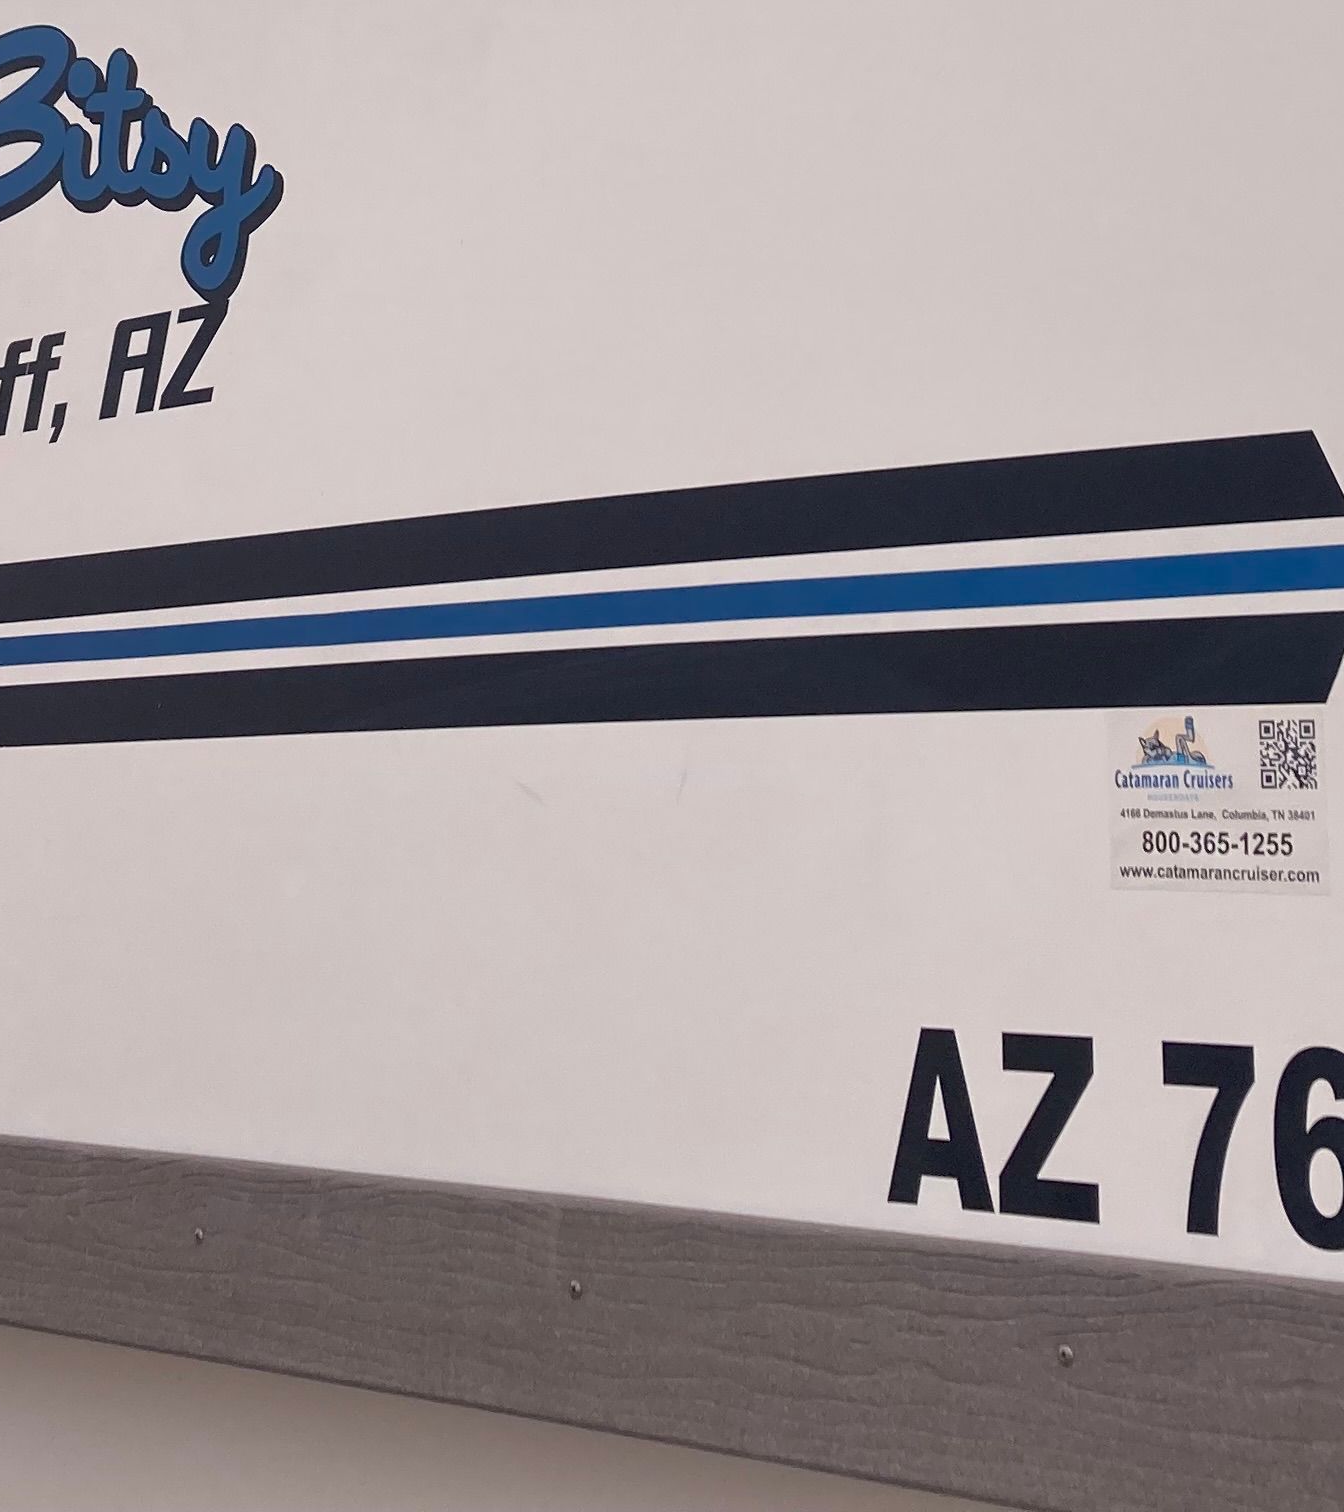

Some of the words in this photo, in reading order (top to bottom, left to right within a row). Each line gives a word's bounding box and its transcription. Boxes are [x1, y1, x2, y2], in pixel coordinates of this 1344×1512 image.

[98, 298, 230, 420] AZ
[1114, 769, 1179, 789] Catamaran
[1183, 770, 1234, 790] Cruisers
[1190, 808, 1217, 820] Lane,
[1222, 809, 1269, 822] Columbia,
[1271, 809, 1285, 820] TN
[1288, 809, 1316, 821] 38401
[1141, 830, 1294, 857] 800-365-1255
[1119, 864, 1320, 883] www.catamarancruiser.com
[887, 1027, 1099, 1224] AZ
